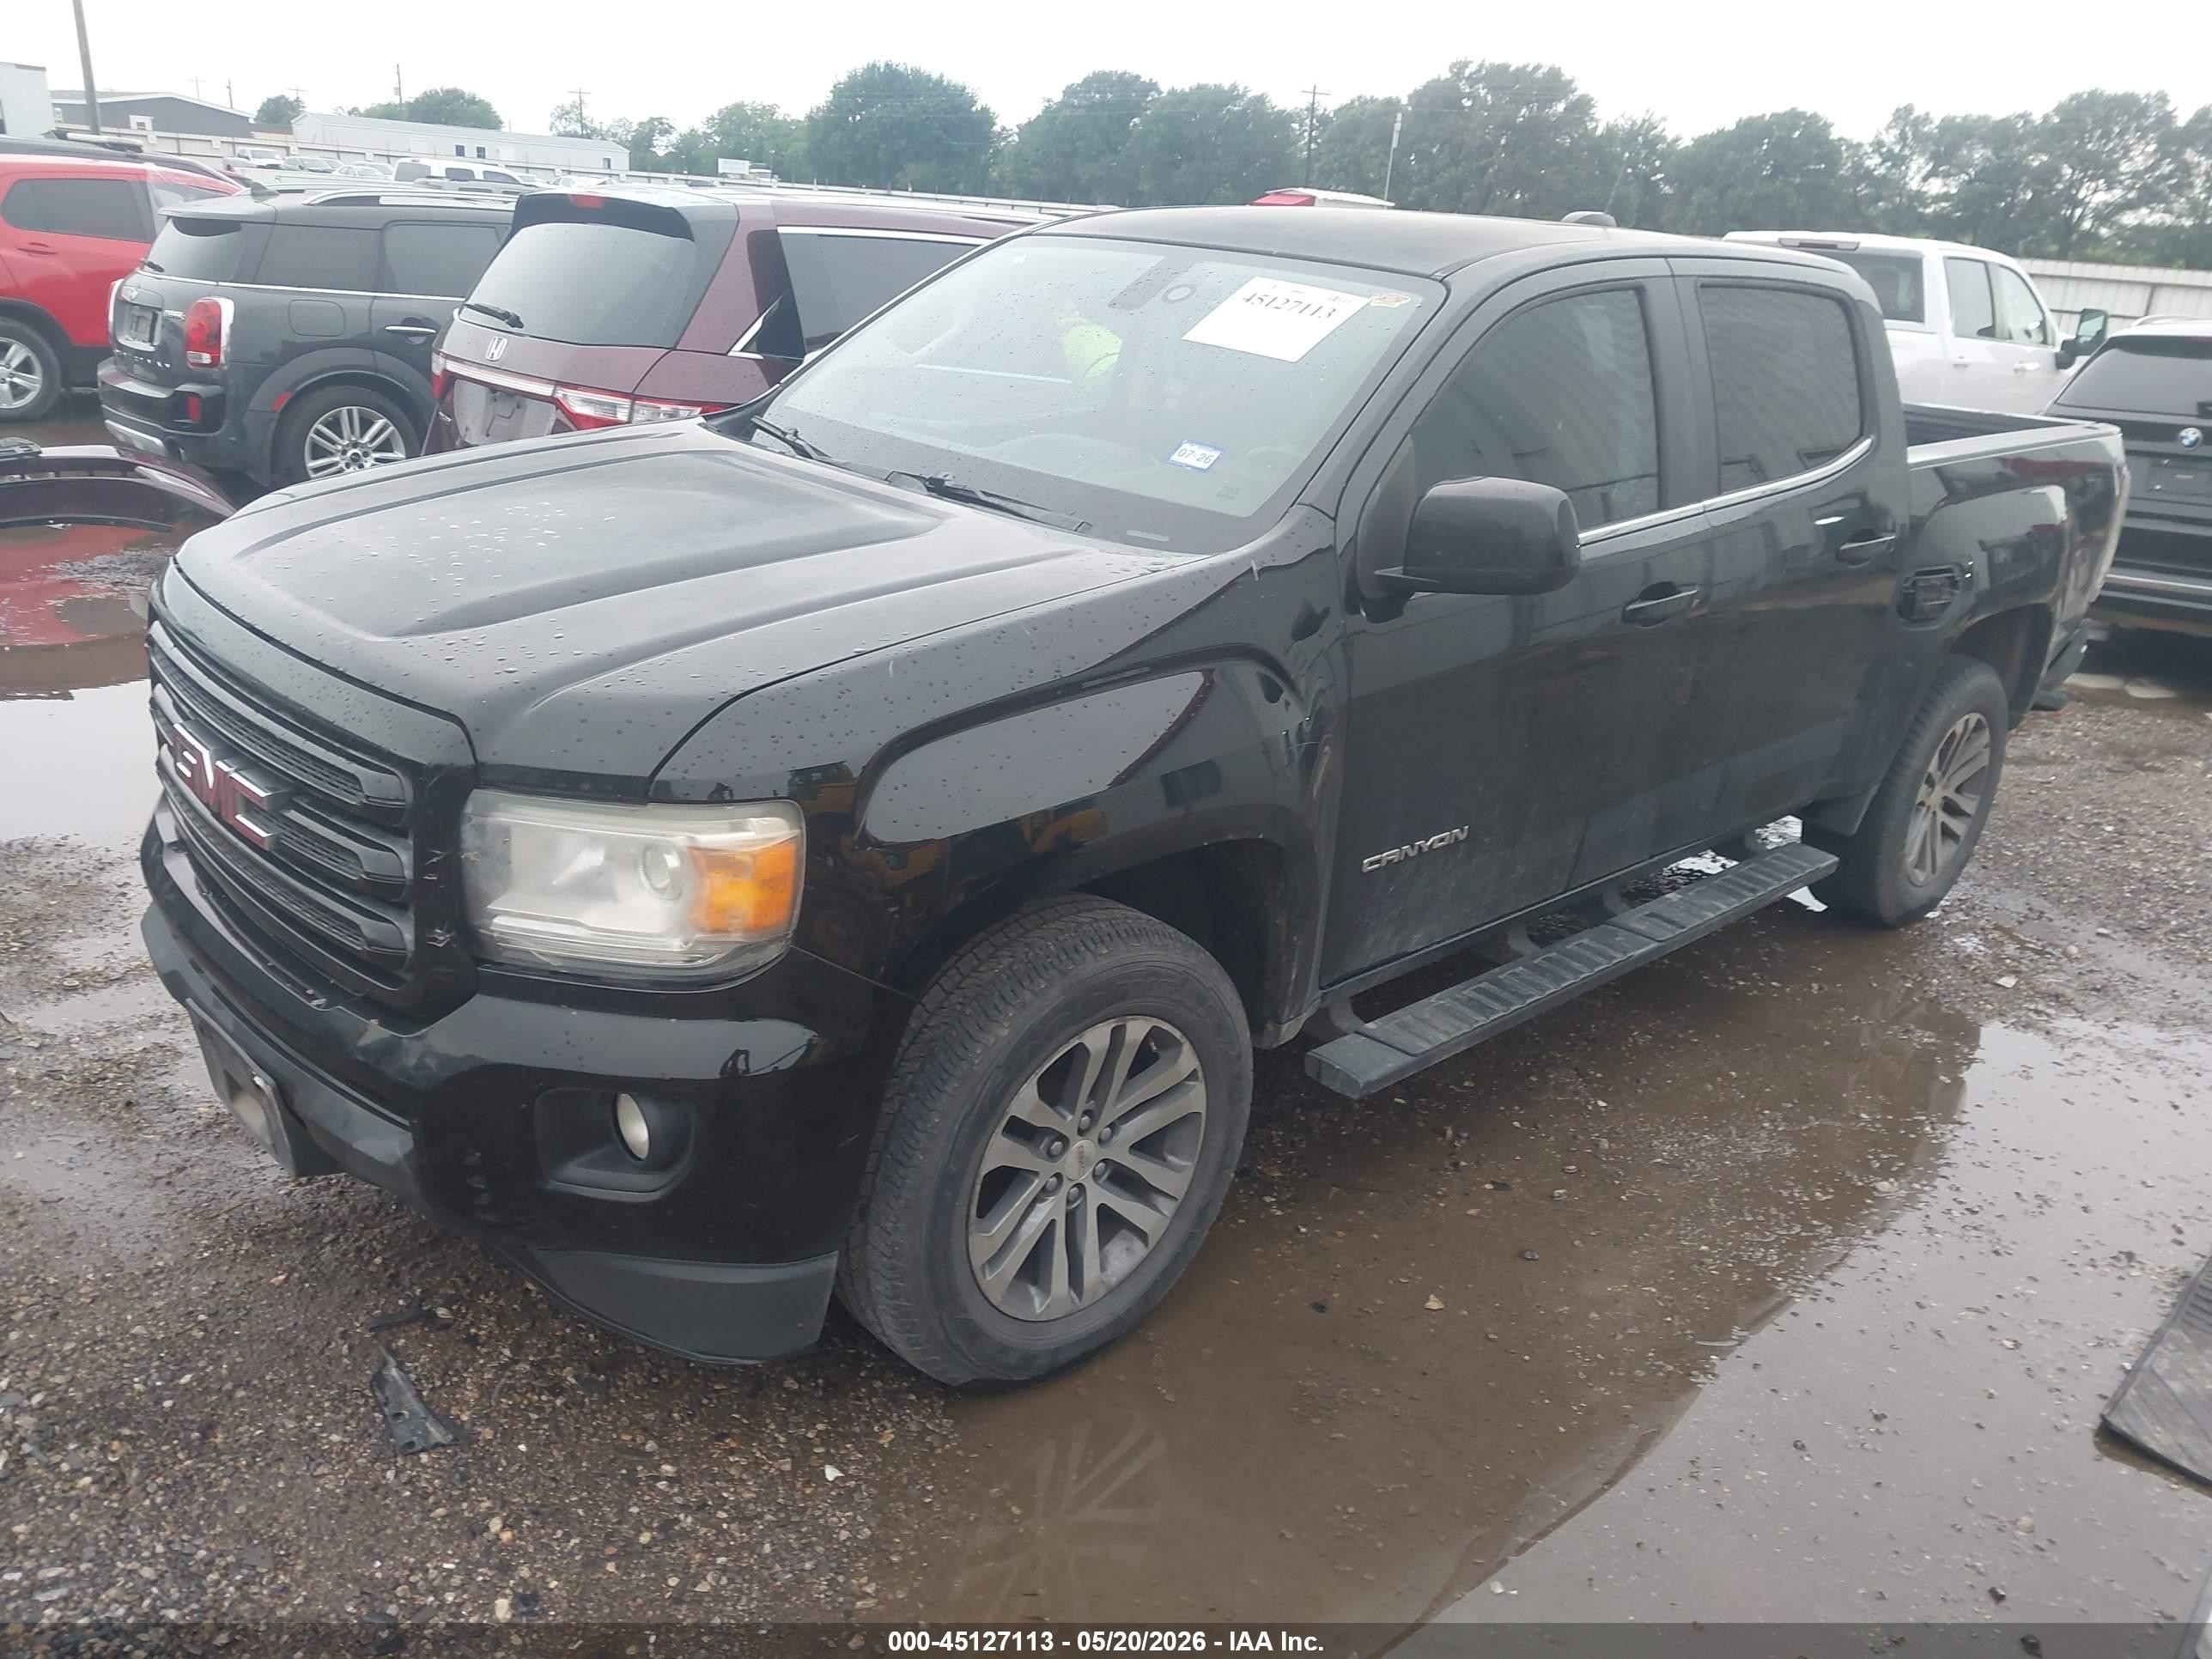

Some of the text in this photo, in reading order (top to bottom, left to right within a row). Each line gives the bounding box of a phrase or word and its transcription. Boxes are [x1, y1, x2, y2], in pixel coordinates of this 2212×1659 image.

[1243, 292, 1337, 319] 45127113
[172, 723, 276, 852] GMC
[1362, 825, 1469, 873] CANYON
